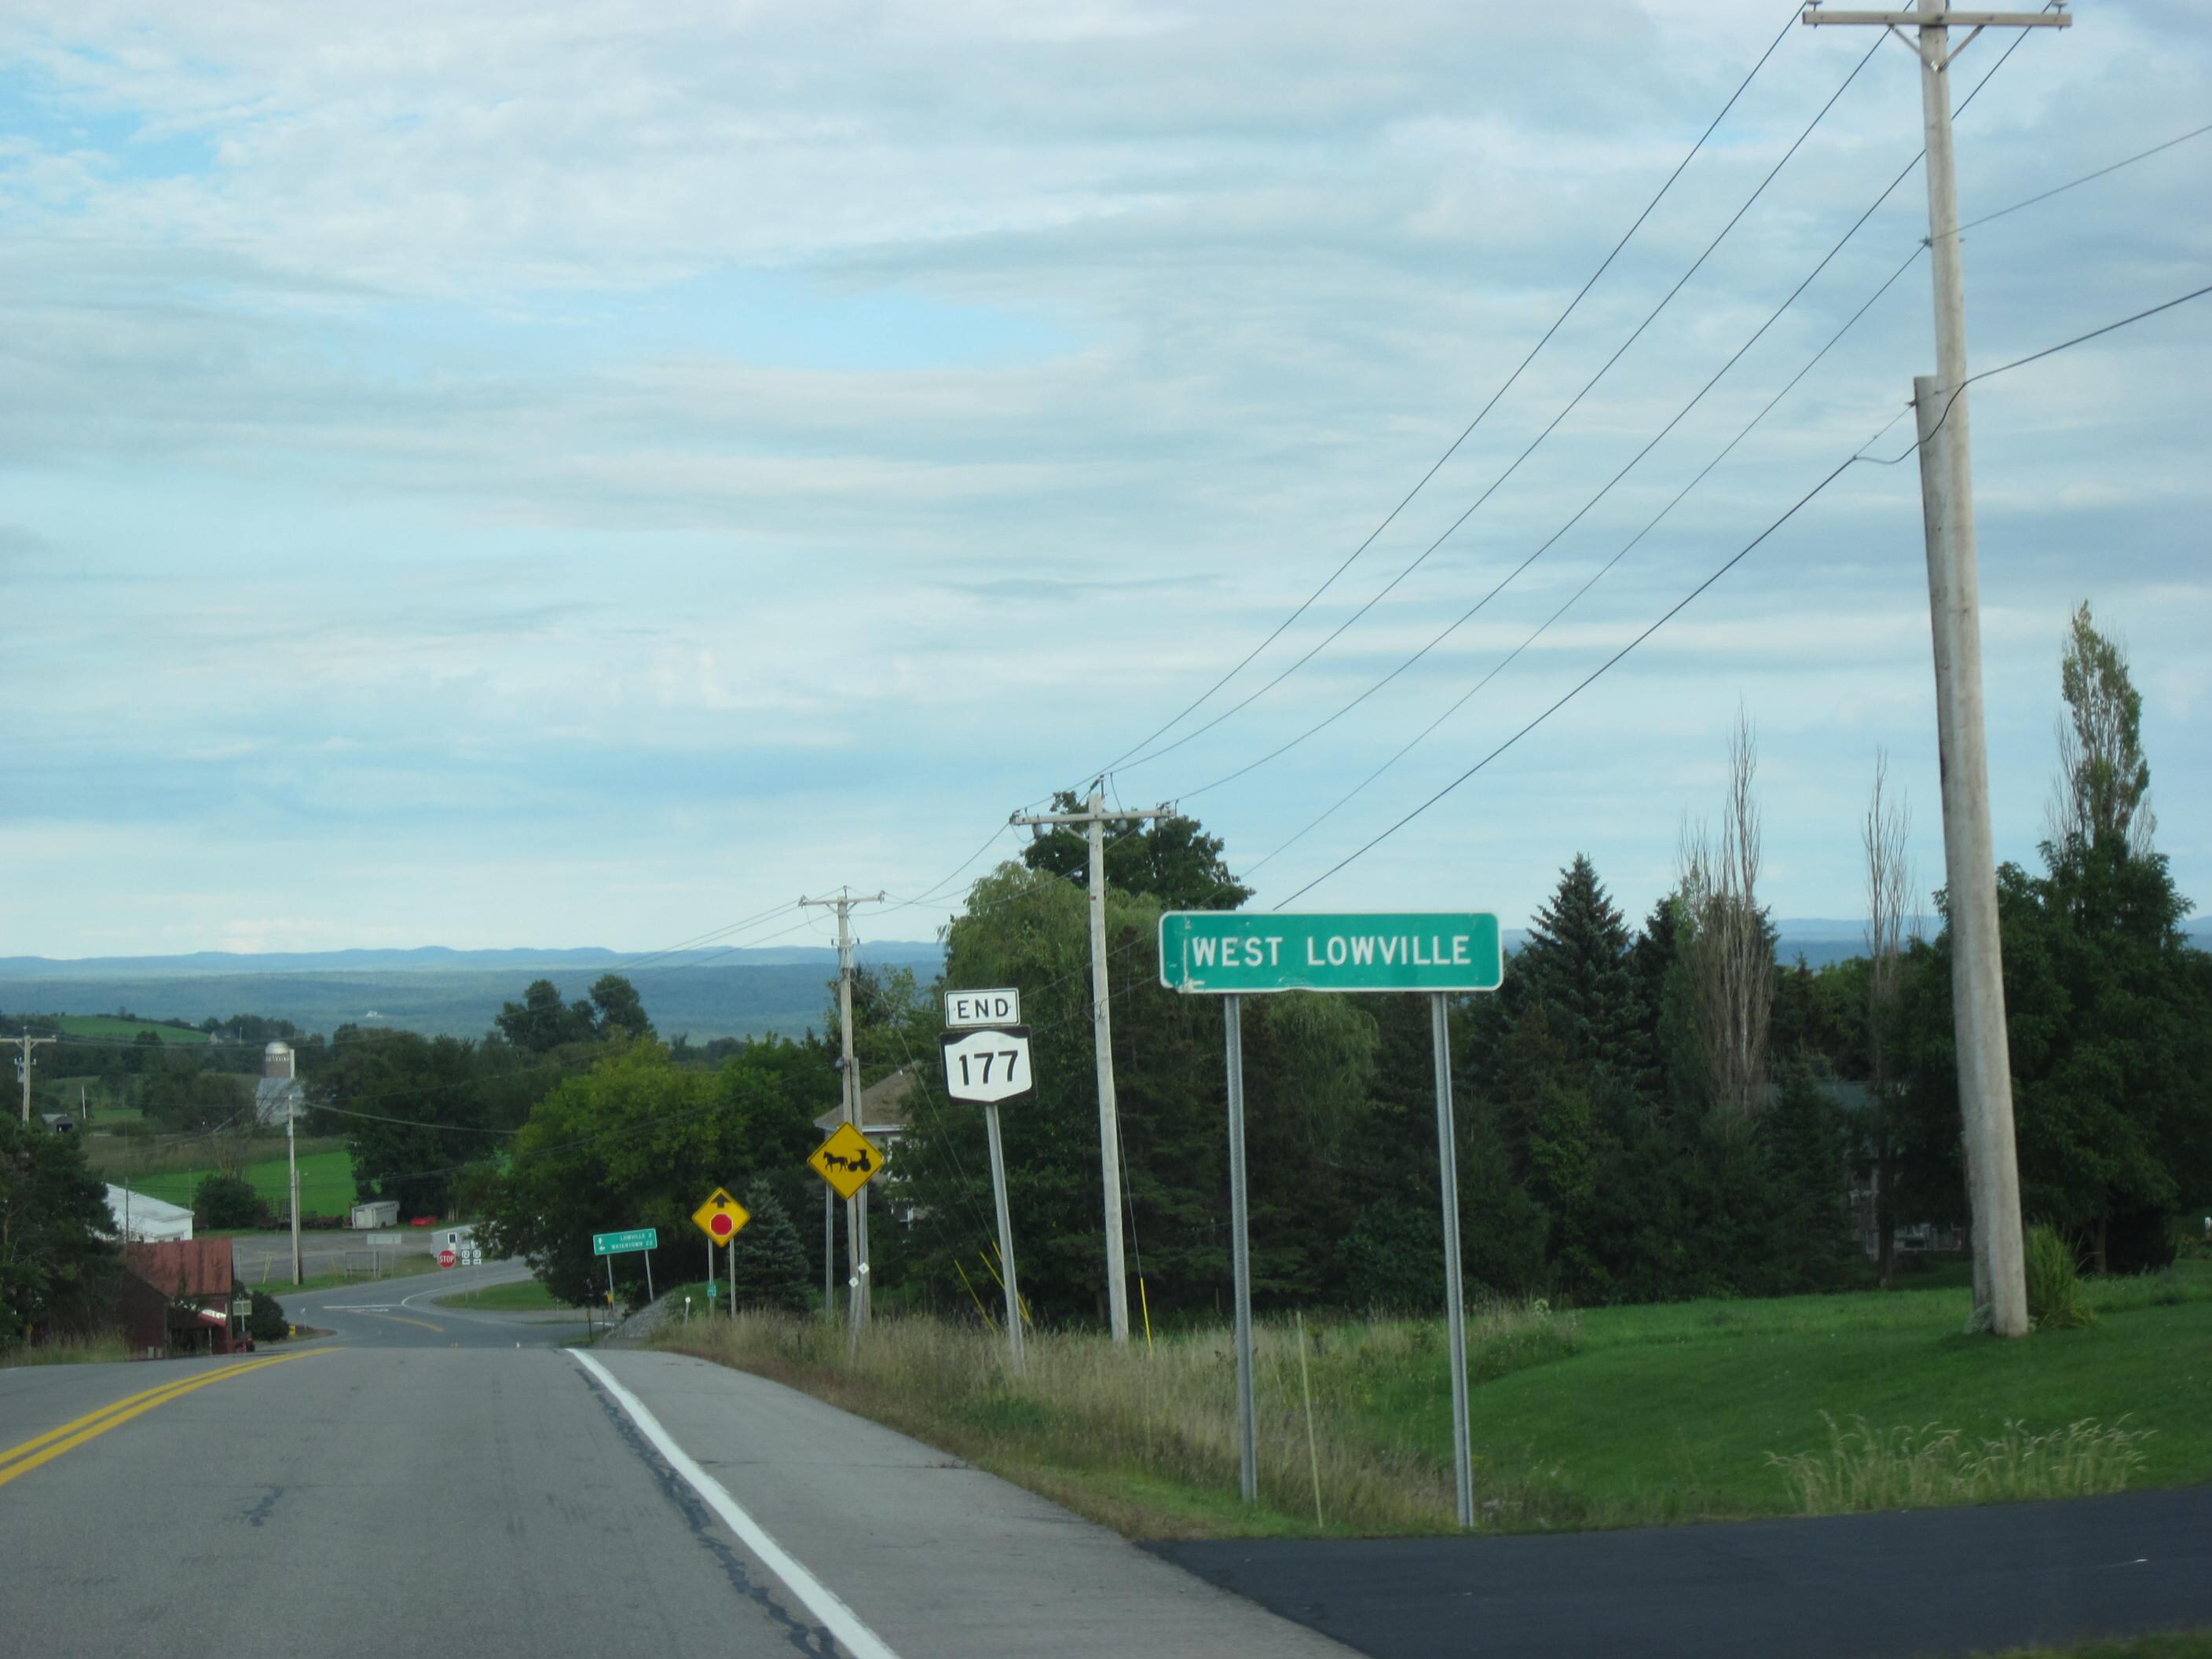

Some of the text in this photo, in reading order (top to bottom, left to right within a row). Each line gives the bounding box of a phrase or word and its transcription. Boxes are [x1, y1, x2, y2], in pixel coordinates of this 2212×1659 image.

[1192, 936, 1472, 967] WEST LOWVILLE
[957, 998, 1009, 1019] END
[958, 1050, 1018, 1086] 177
[620, 1232, 645, 1241] LOWVILLE
